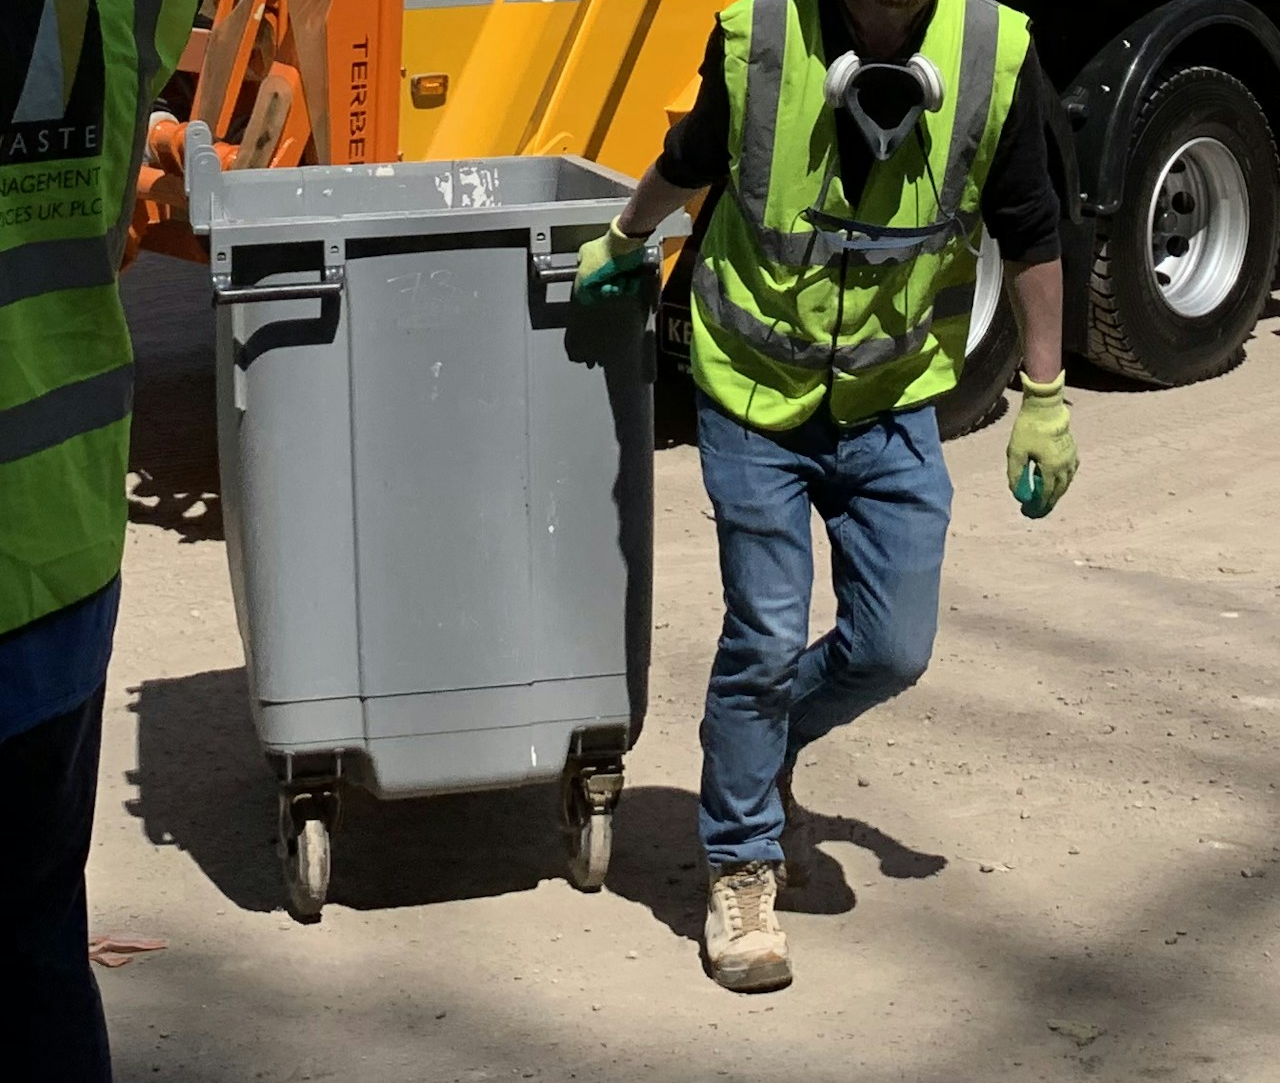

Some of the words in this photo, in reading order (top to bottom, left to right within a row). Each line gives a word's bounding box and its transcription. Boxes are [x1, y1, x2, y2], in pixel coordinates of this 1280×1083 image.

[348, 33, 369, 165] TERBE
[38, 202, 65, 222] UK
[71, 198, 104, 218] PLC
